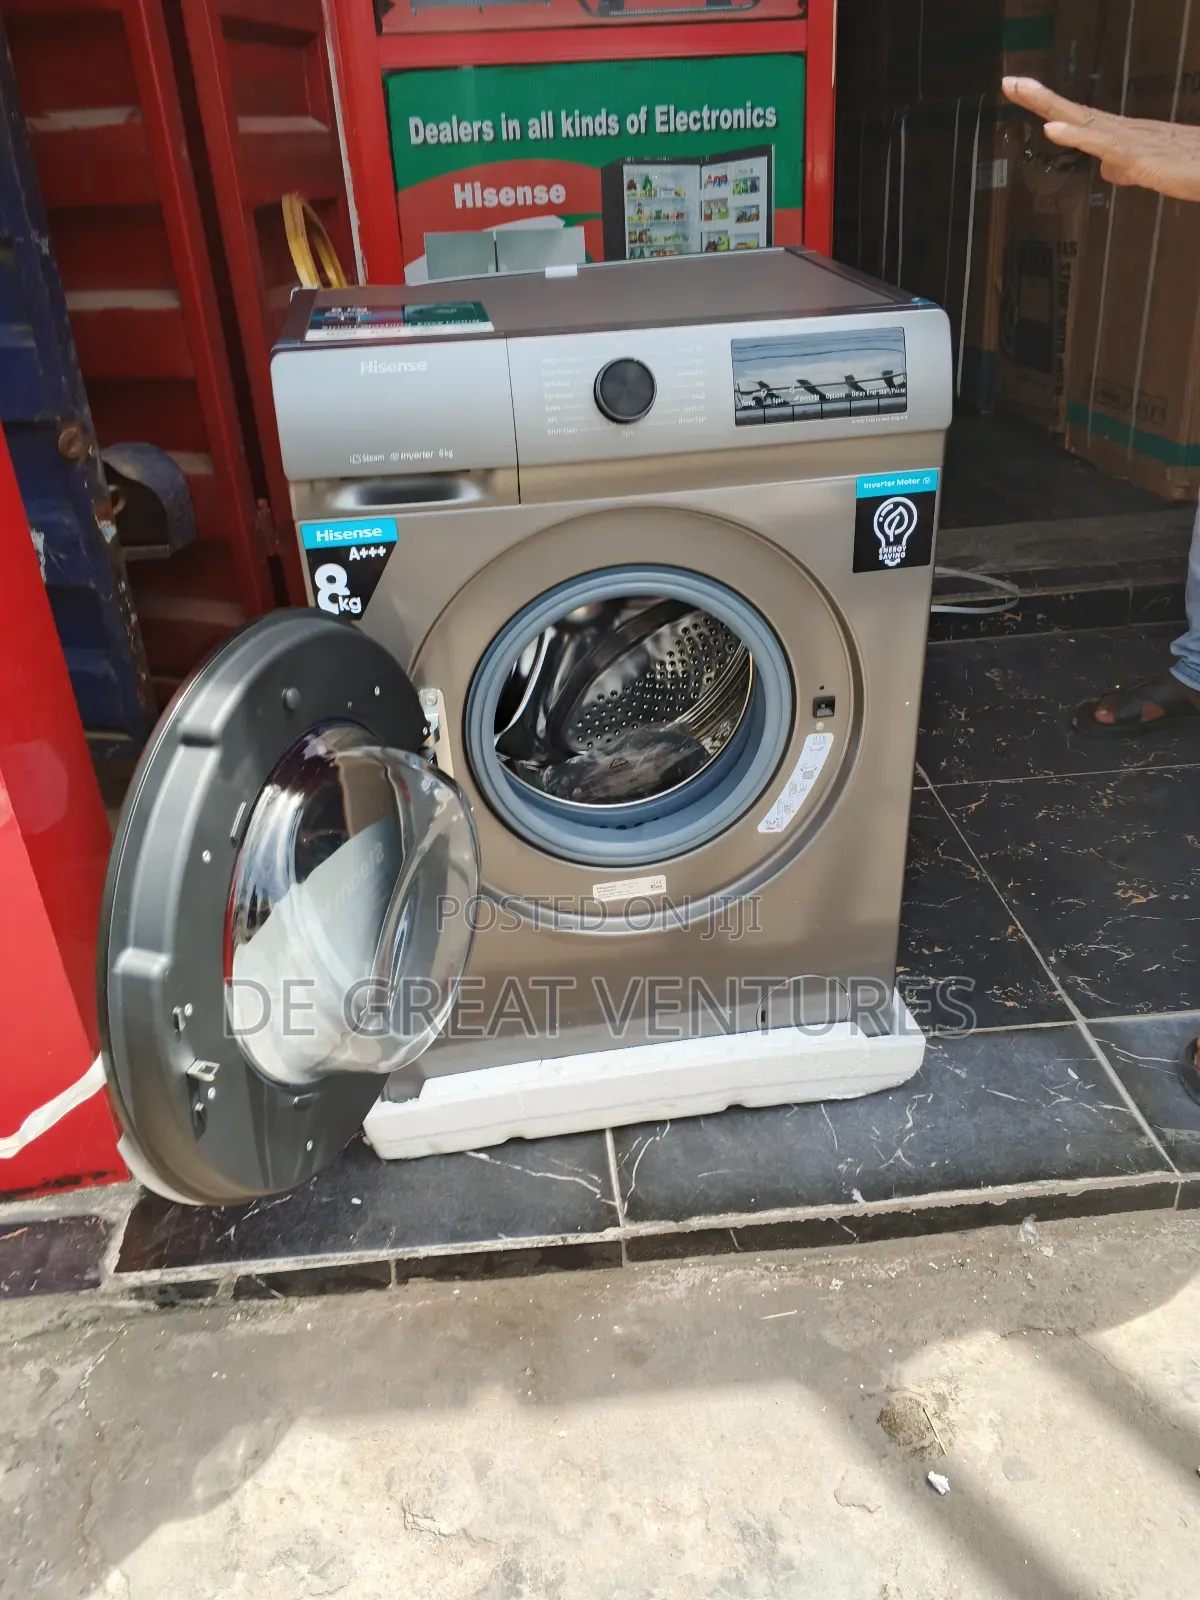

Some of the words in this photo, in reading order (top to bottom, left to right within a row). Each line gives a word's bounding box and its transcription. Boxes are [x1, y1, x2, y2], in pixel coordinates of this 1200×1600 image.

[408, 114, 495, 147] Dealers
[501, 109, 522, 142] in
[527, 109, 555, 141] all
[560, 105, 620, 138] kinds
[626, 104, 649, 136] of
[654, 100, 777, 134] Electronics
[453, 181, 566, 209] Hisense
[359, 359, 428, 375] Hisense
[400, 449, 434, 461] Inverter
[863, 480, 895, 489] Inverter
[896, 477, 921, 486] Motor
[316, 527, 383, 542] Hisense
[348, 545, 387, 561] A+++
[878, 545, 907, 555] ENERGY
[878, 551, 906, 561] SAVING
